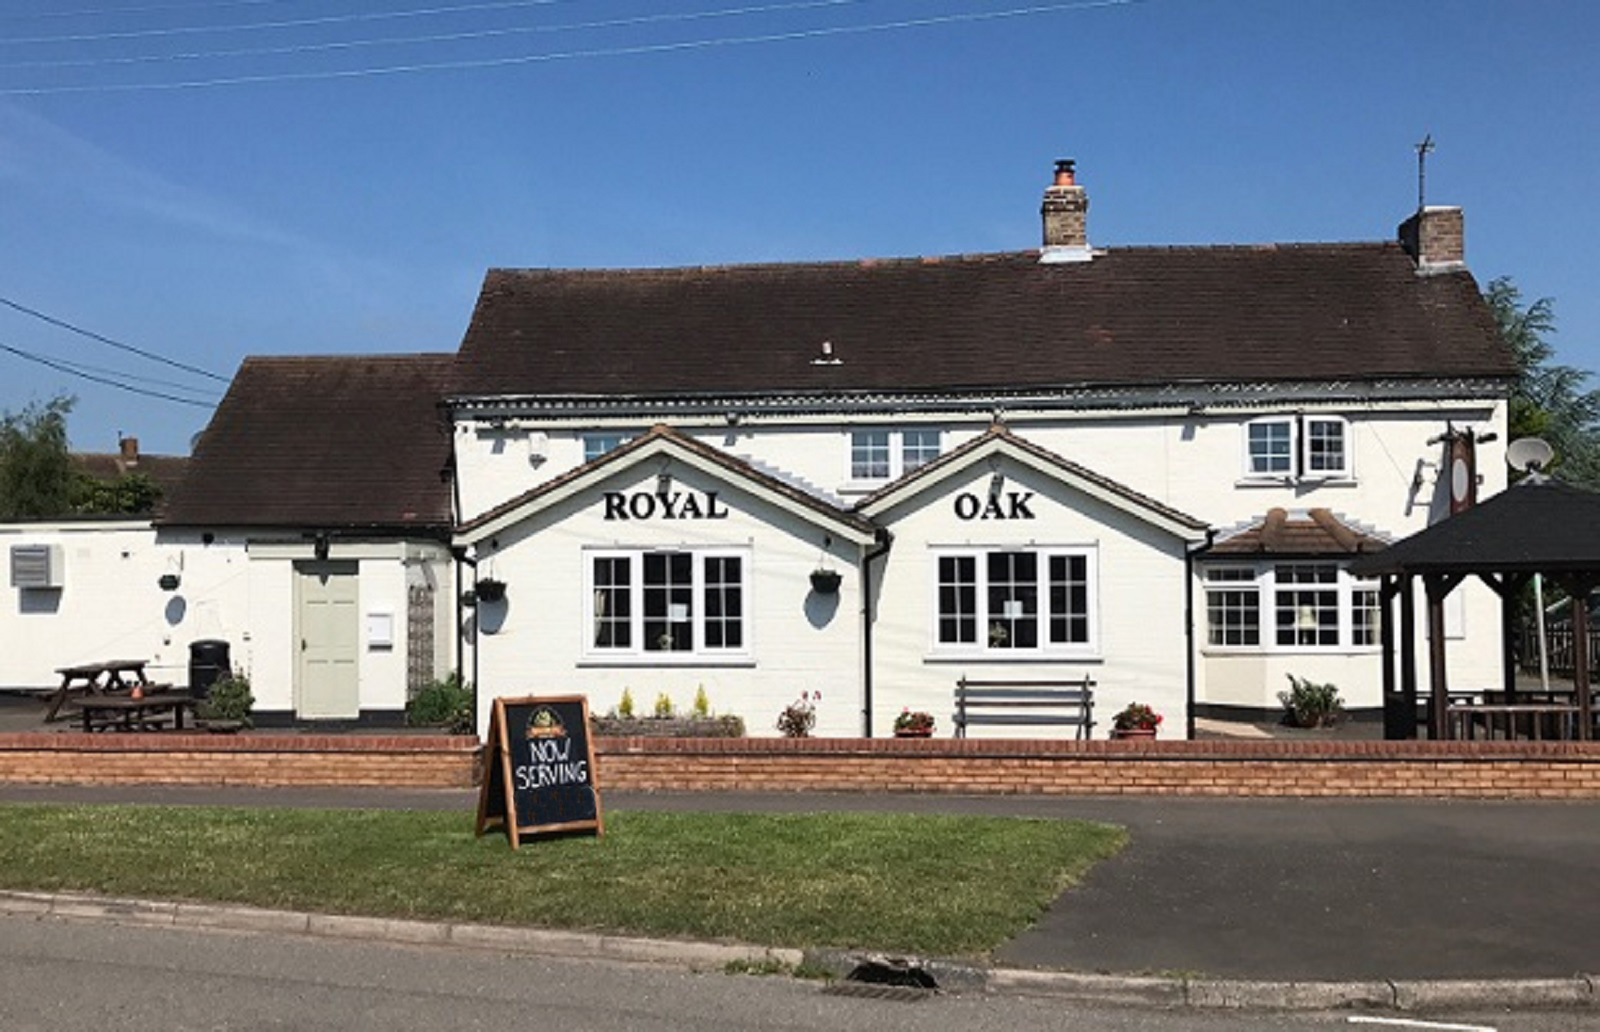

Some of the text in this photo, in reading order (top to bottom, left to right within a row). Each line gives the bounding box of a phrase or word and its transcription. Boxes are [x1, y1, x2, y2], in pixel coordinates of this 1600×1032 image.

[603, 492, 729, 520] ROYAL
[954, 492, 1036, 520] OAK
[530, 738, 571, 762] NOW
[516, 761, 587, 789] SERVING
